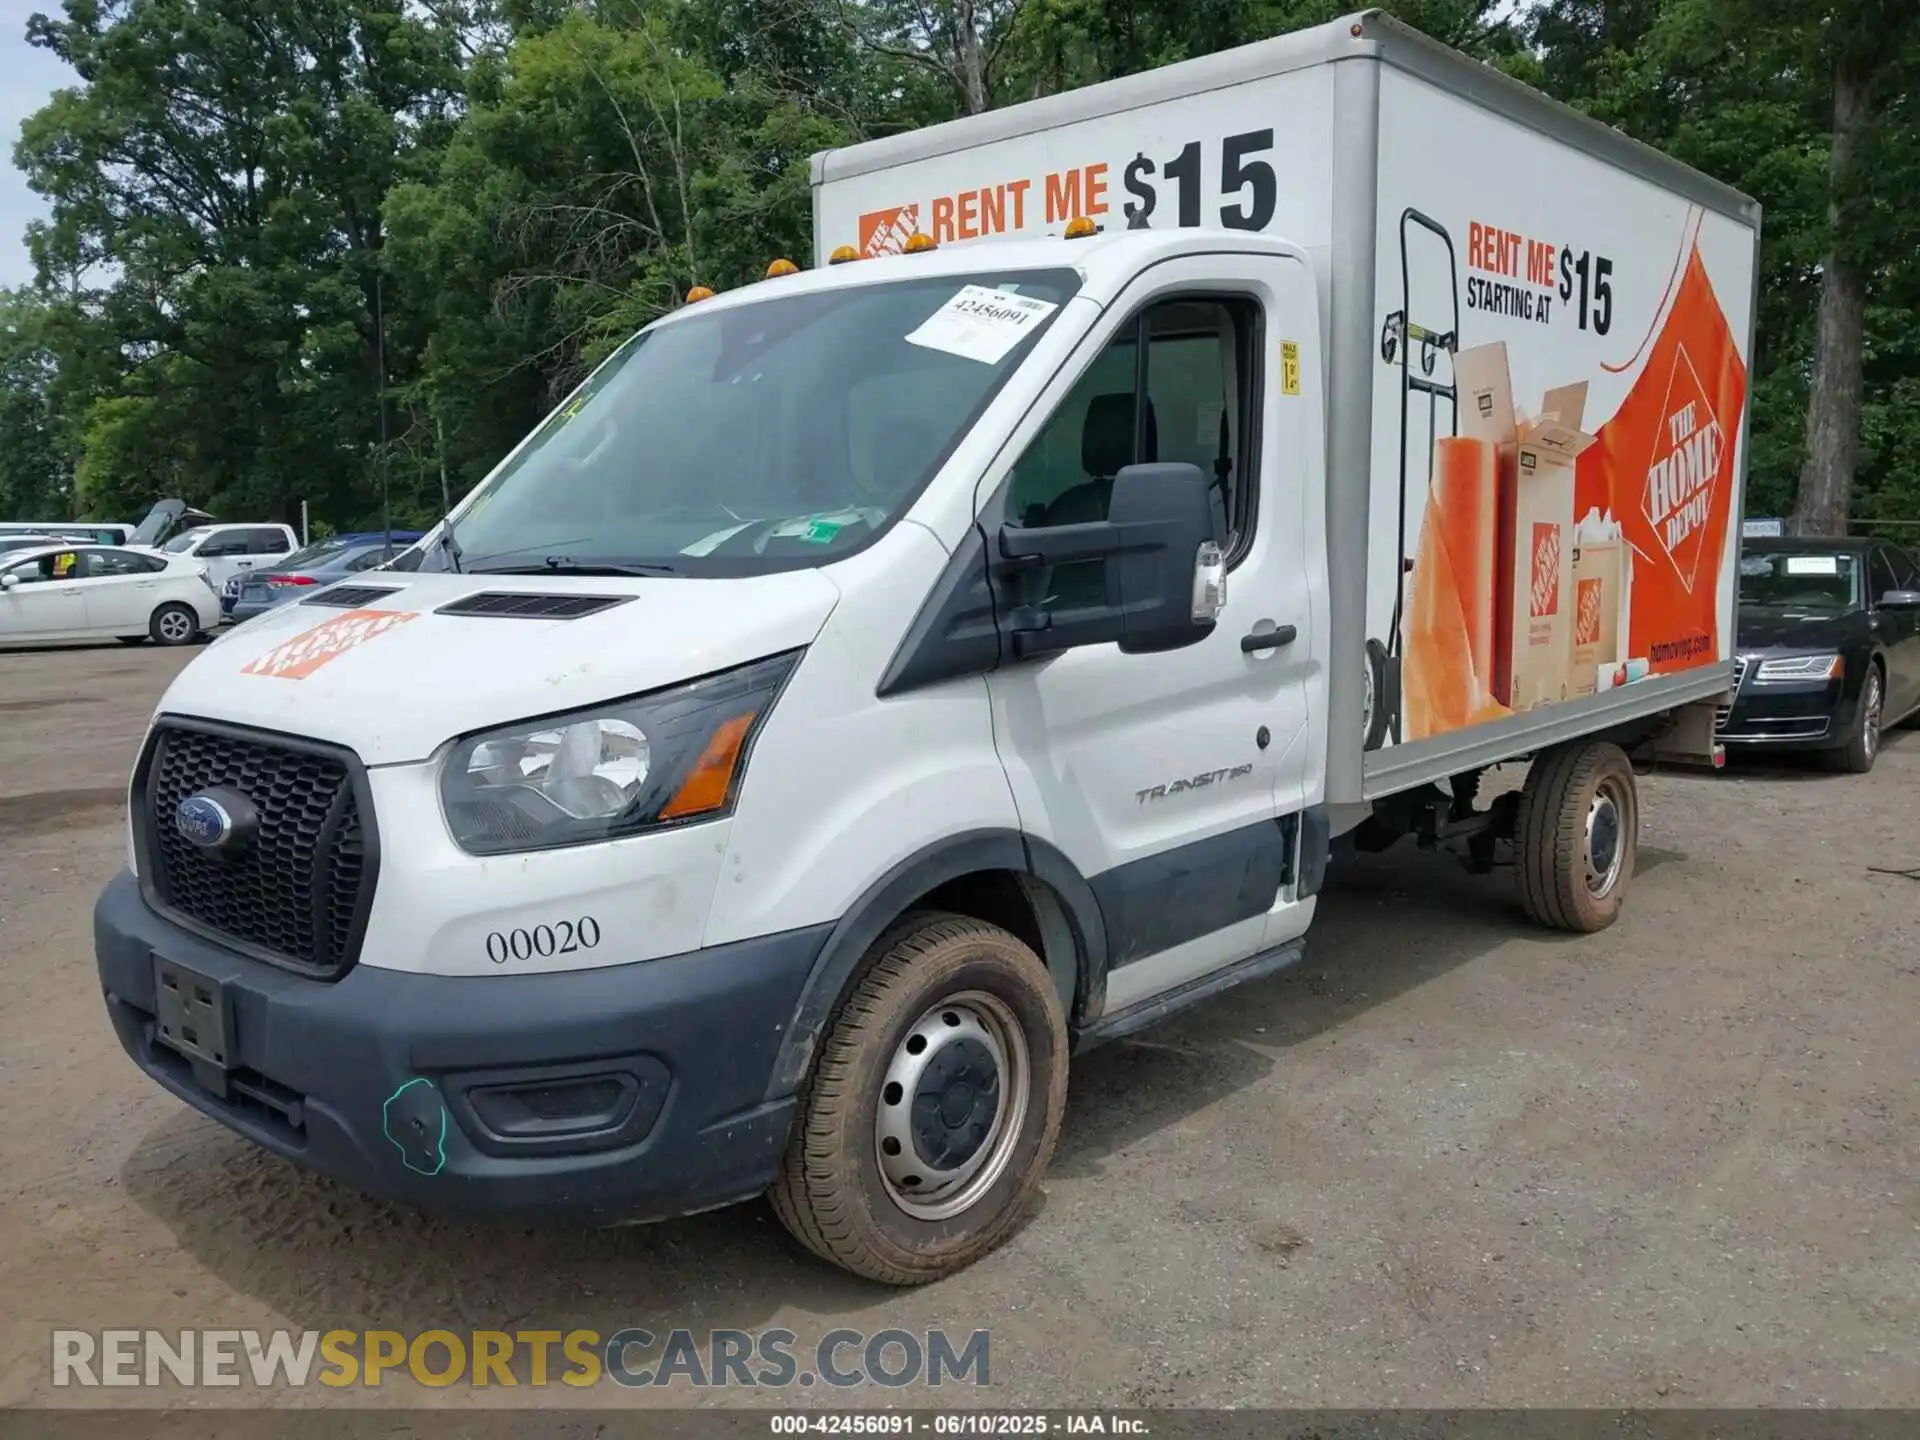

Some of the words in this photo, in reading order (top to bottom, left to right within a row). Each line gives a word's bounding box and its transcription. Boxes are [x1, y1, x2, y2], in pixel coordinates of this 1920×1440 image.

[932, 179, 1031, 244] RENT
[1045, 162, 1109, 225] ME
[1123, 127, 1277, 232] $15
[1469, 220, 1522, 278] RENT
[1527, 238, 1555, 288] ME
[1467, 276, 1533, 321] STARTING
[1535, 293, 1552, 325] AT
[1559, 243, 1613, 336] $15
[1669, 400, 1697, 447] THE
[1648, 419, 1719, 527] HOME
[1665, 487, 1709, 553] DEPOT
[1135, 768, 1229, 804] TRANSIT
[486, 915, 600, 964] 00020
